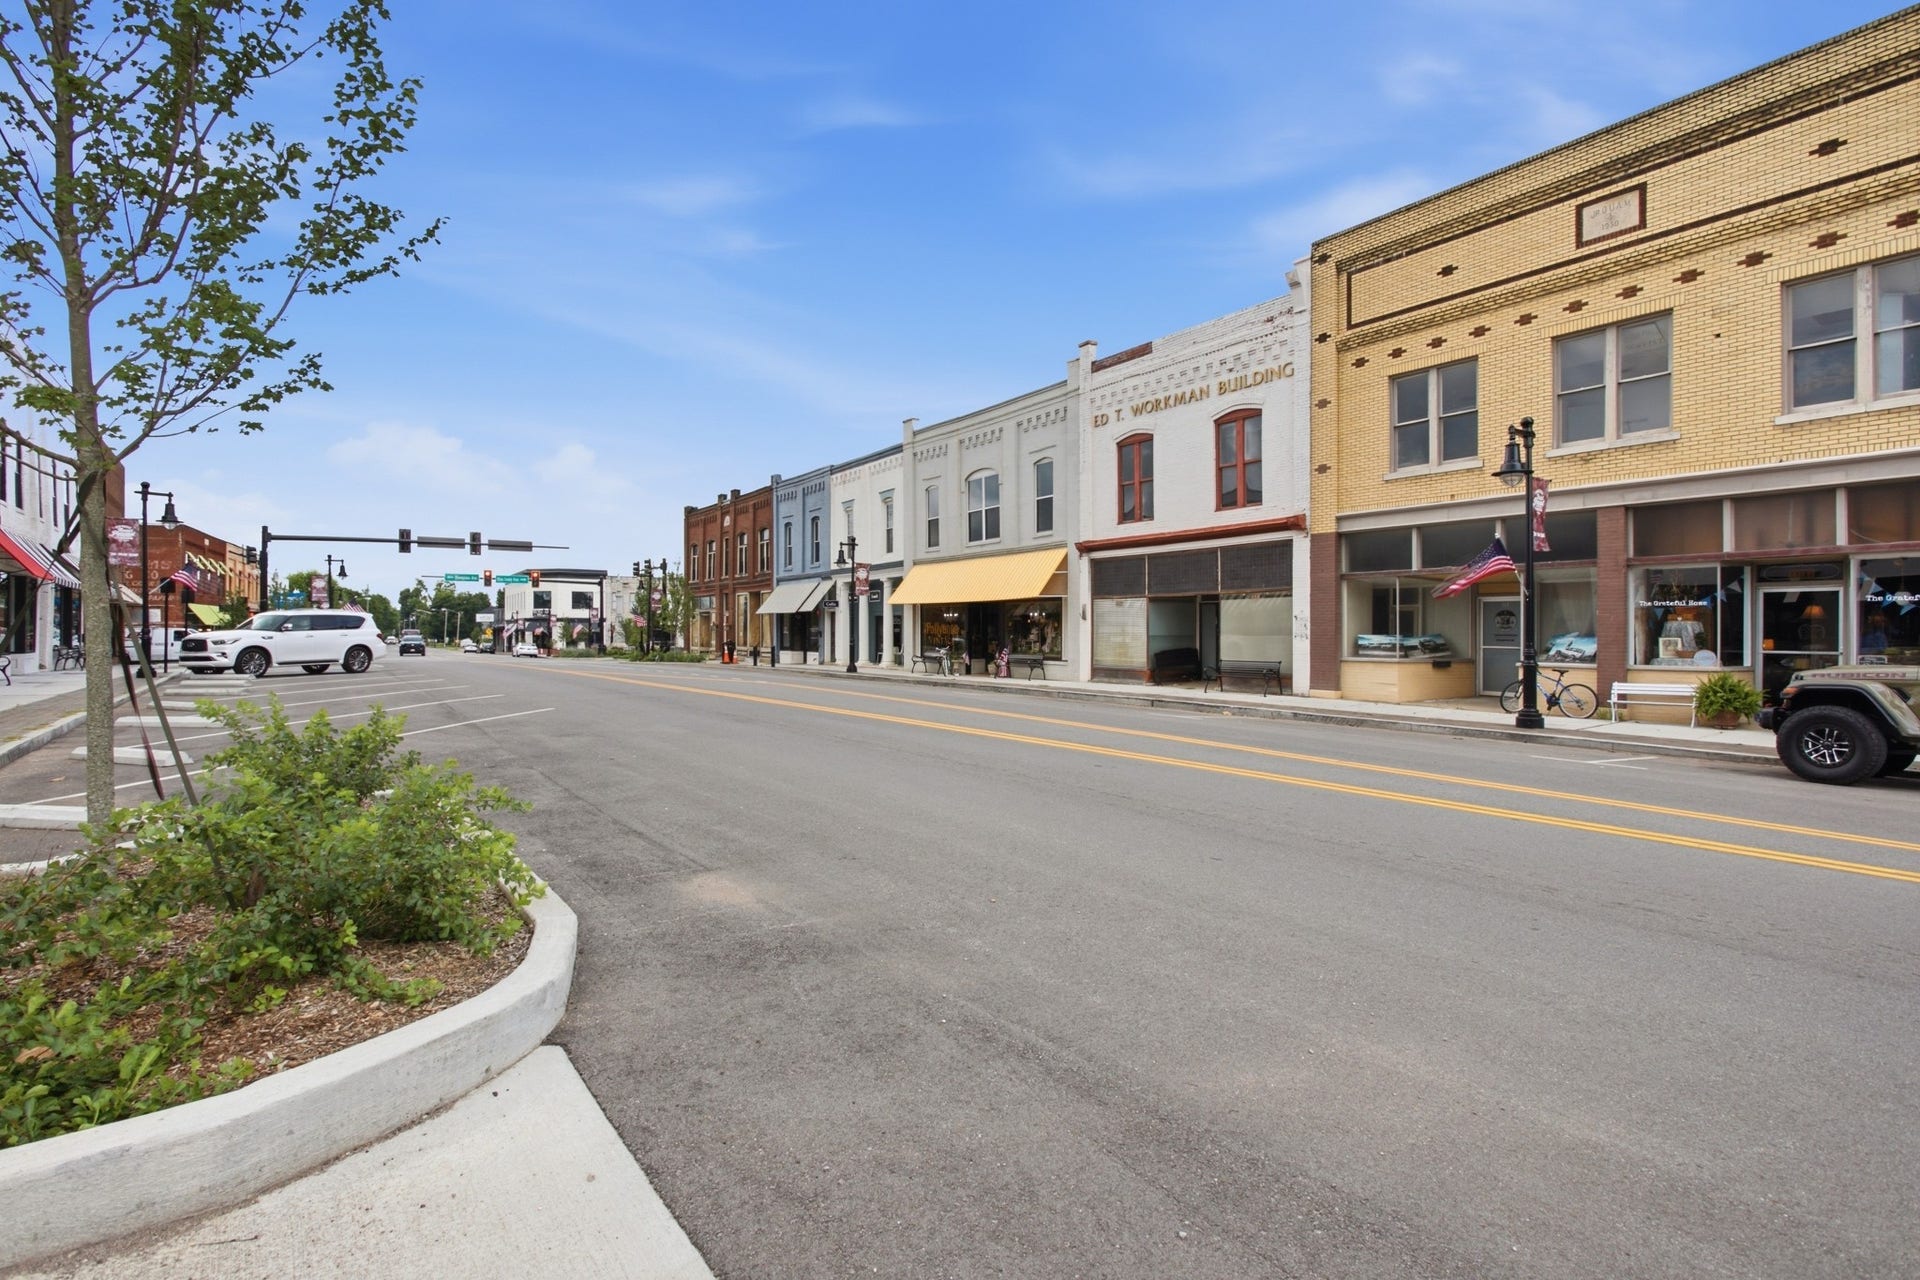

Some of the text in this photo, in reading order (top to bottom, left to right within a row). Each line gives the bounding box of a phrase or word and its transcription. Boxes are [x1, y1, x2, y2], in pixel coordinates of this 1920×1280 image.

[1093, 362, 1295, 428] ED T. WORKMAN BUILDING
